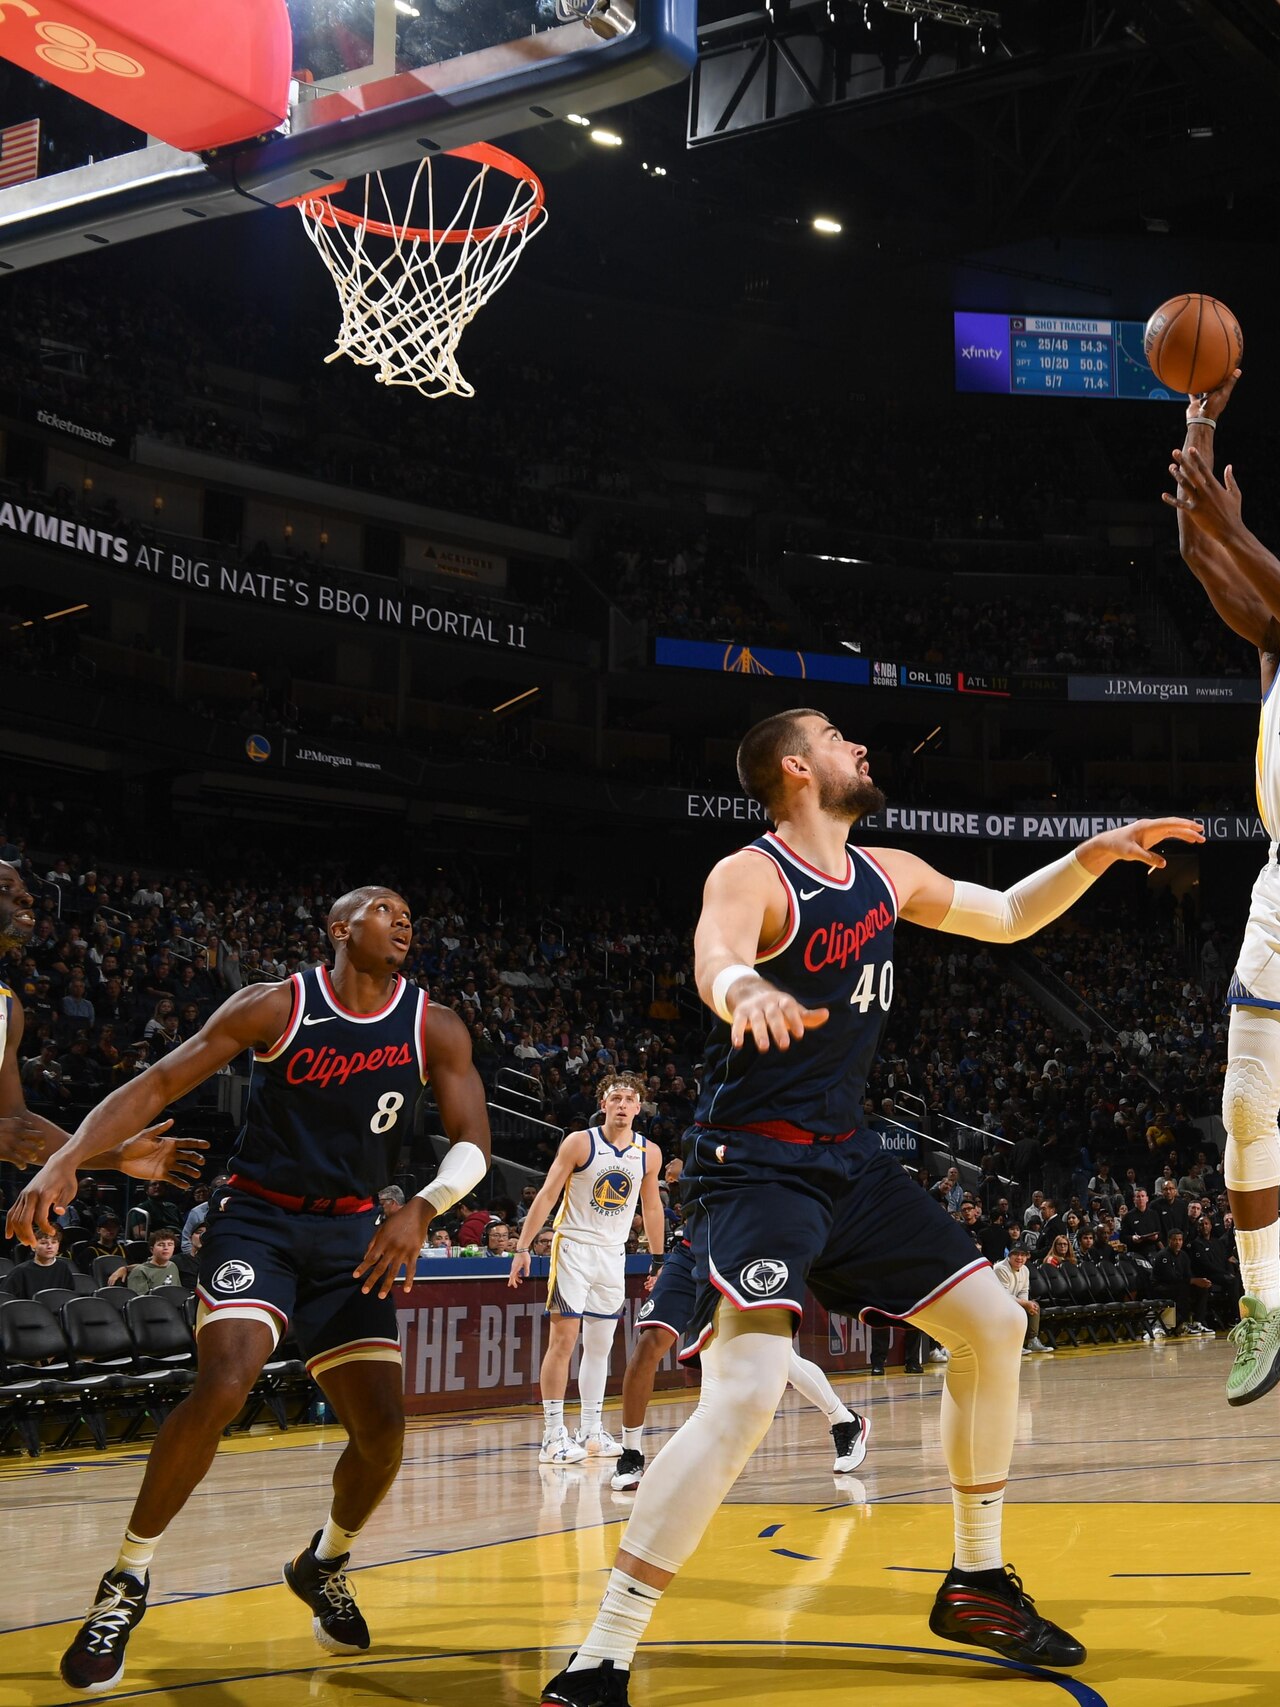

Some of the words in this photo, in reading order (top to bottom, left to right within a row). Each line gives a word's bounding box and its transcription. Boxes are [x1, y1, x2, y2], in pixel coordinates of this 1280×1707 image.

[1035, 319, 1057, 331] SHOT
[1060, 321, 1098, 333] TRACKER
[961, 345, 1002, 361] xfinity
[1015, 340, 1027, 348] FG
[1038, 338, 1068, 351] 25/46
[1015, 358, 1031, 367] 3PT
[1040, 357, 1069, 370] 10/20
[1016, 377, 1026, 385] FT
[1045, 375, 1062, 388] 5/7
[36, 409, 116, 447] ticketmaster
[0, 500, 129, 563] AYMENTS
[134, 544, 165, 574] AT
[171, 554, 210, 588] BIG
[220, 565, 310, 607] NATE'S
[318, 586, 370, 621] BBQ
[378, 597, 402, 625] IN
[411, 604, 500, 644] PORTAL
[507, 623, 527, 649] 11
[880, 662, 897, 679] NBA
[909, 671, 931, 683] ORL
[934, 672, 952, 686] 105
[873, 677, 897, 687] SCORES
[967, 677, 988, 688] ATL
[1104, 680, 1189, 700] J.P.Morgan
[1196, 688, 1233, 697] PAYMENTS
[886, 808, 979, 835] FUTURE
[986, 814, 1016, 837] OF
[803, 901, 893, 973] Clippers
[850, 960, 894, 1013] 40
[287, 1042, 413, 1088] Clippers
[370, 1091, 404, 1134] 8
[596, 1165, 621, 1177] GOLDEN
[619, 1181, 628, 1192] 2
[589, 1198, 629, 1217] WARRIORS
[396, 1305, 468, 1395] THE
